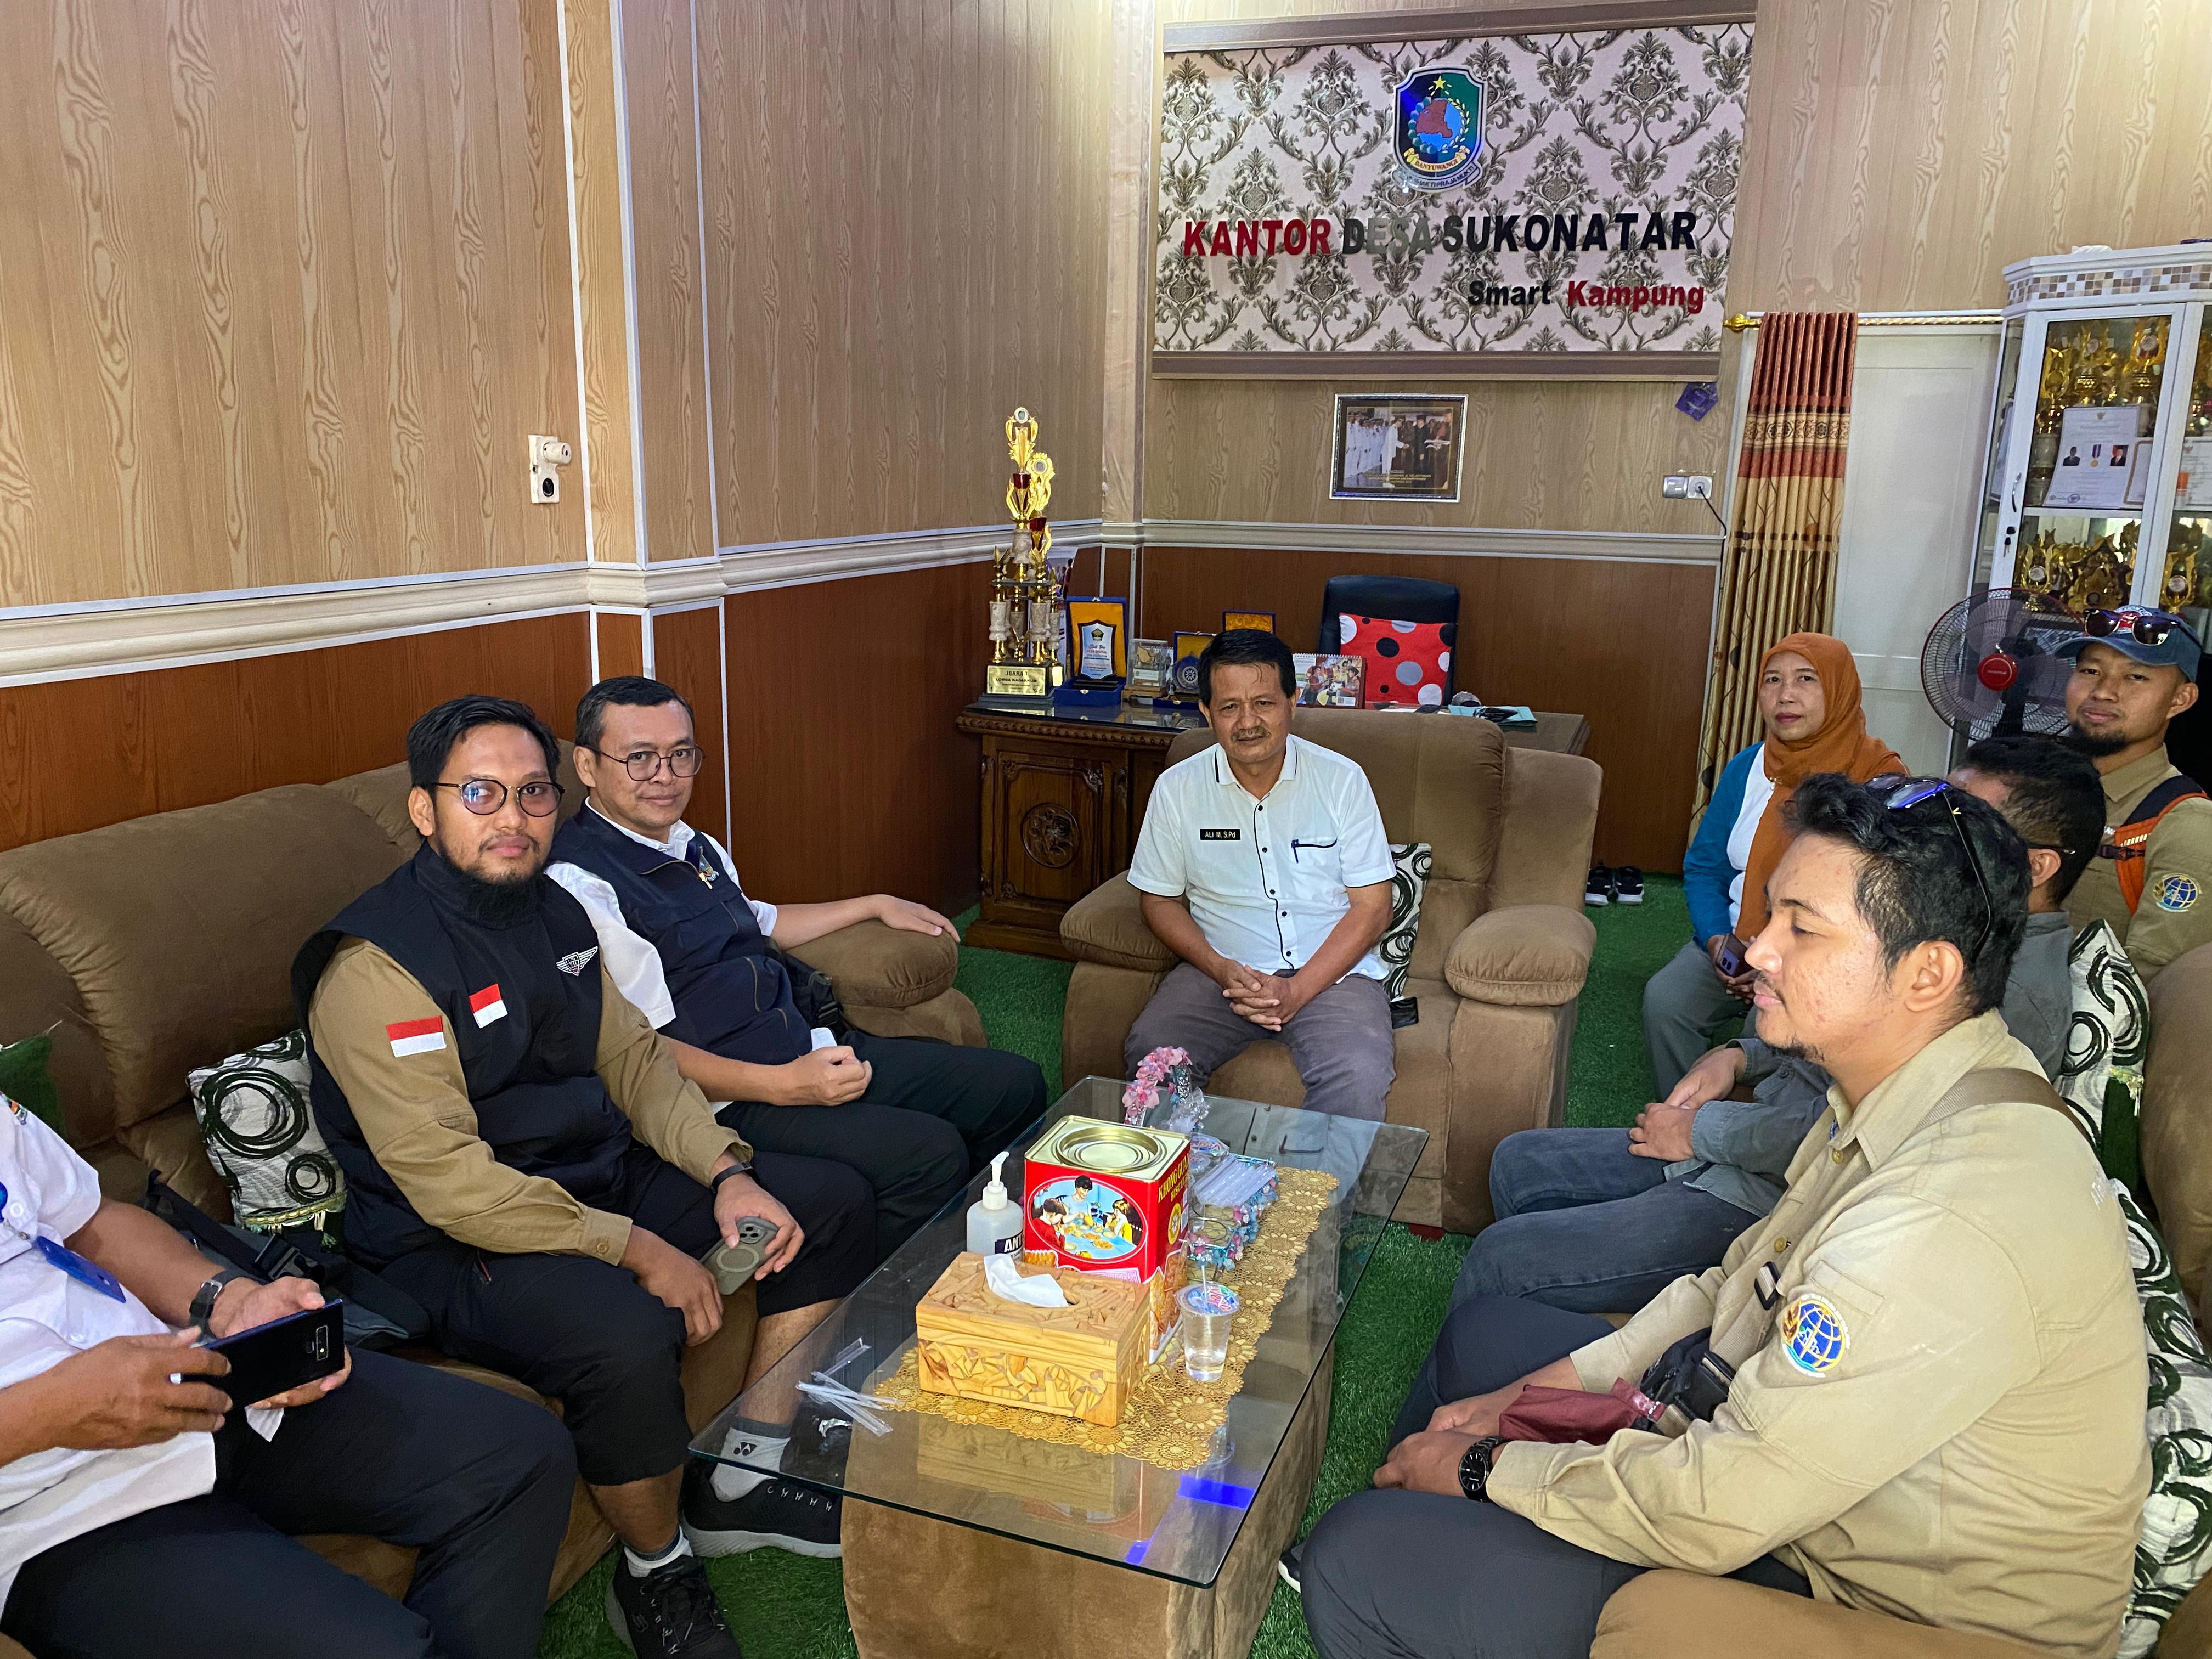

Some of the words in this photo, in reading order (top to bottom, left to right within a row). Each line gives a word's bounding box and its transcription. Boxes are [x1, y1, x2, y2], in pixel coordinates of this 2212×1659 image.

[1415, 159, 1458, 170] BANYUWANGI
[1183, 219, 1331, 256] KANTOR
[1342, 218, 1434, 255] DESA
[1442, 211, 1697, 253] SUKONATAR
[1468, 280, 1551, 306] Smart
[1567, 280, 1705, 314] Kampung
[1158, 1168, 1177, 1203] KHONG
